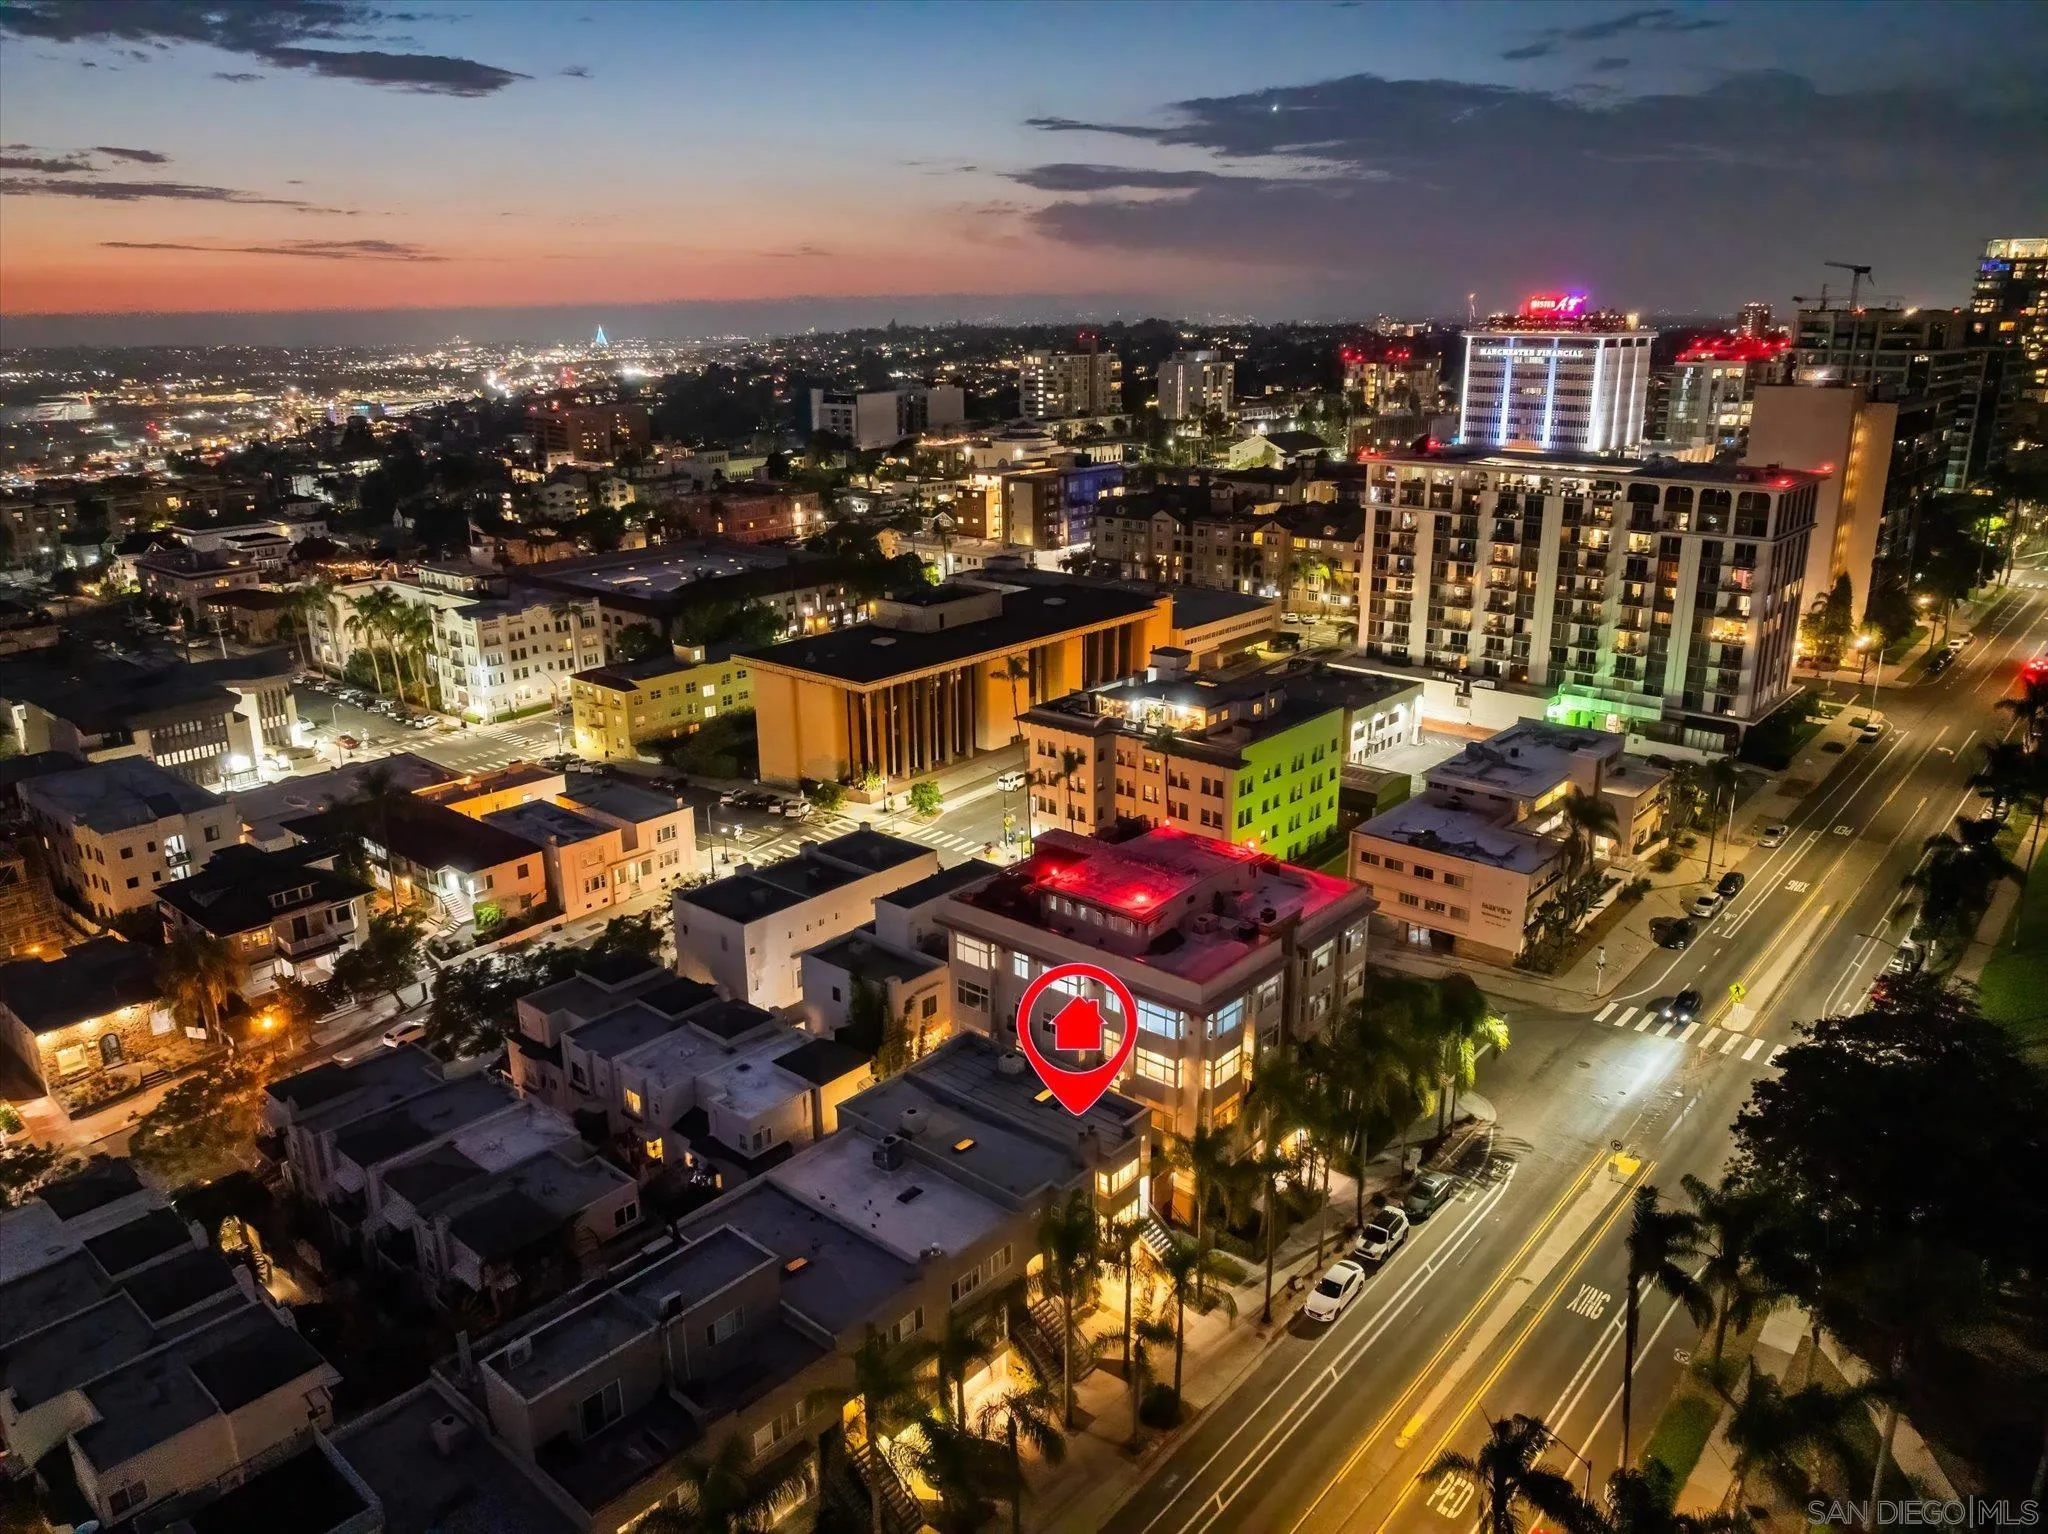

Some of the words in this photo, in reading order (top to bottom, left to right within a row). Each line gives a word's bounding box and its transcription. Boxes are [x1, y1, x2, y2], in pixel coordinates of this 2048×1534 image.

[1480, 348, 1535, 356] MANCHESTER
[1537, 349, 1583, 357] FINANCIAL
[1833, 825, 1854, 836] PED
[1785, 880, 1810, 893] XING
[1566, 1283, 1611, 1320] XING
[1426, 1472, 1475, 1518] PED
